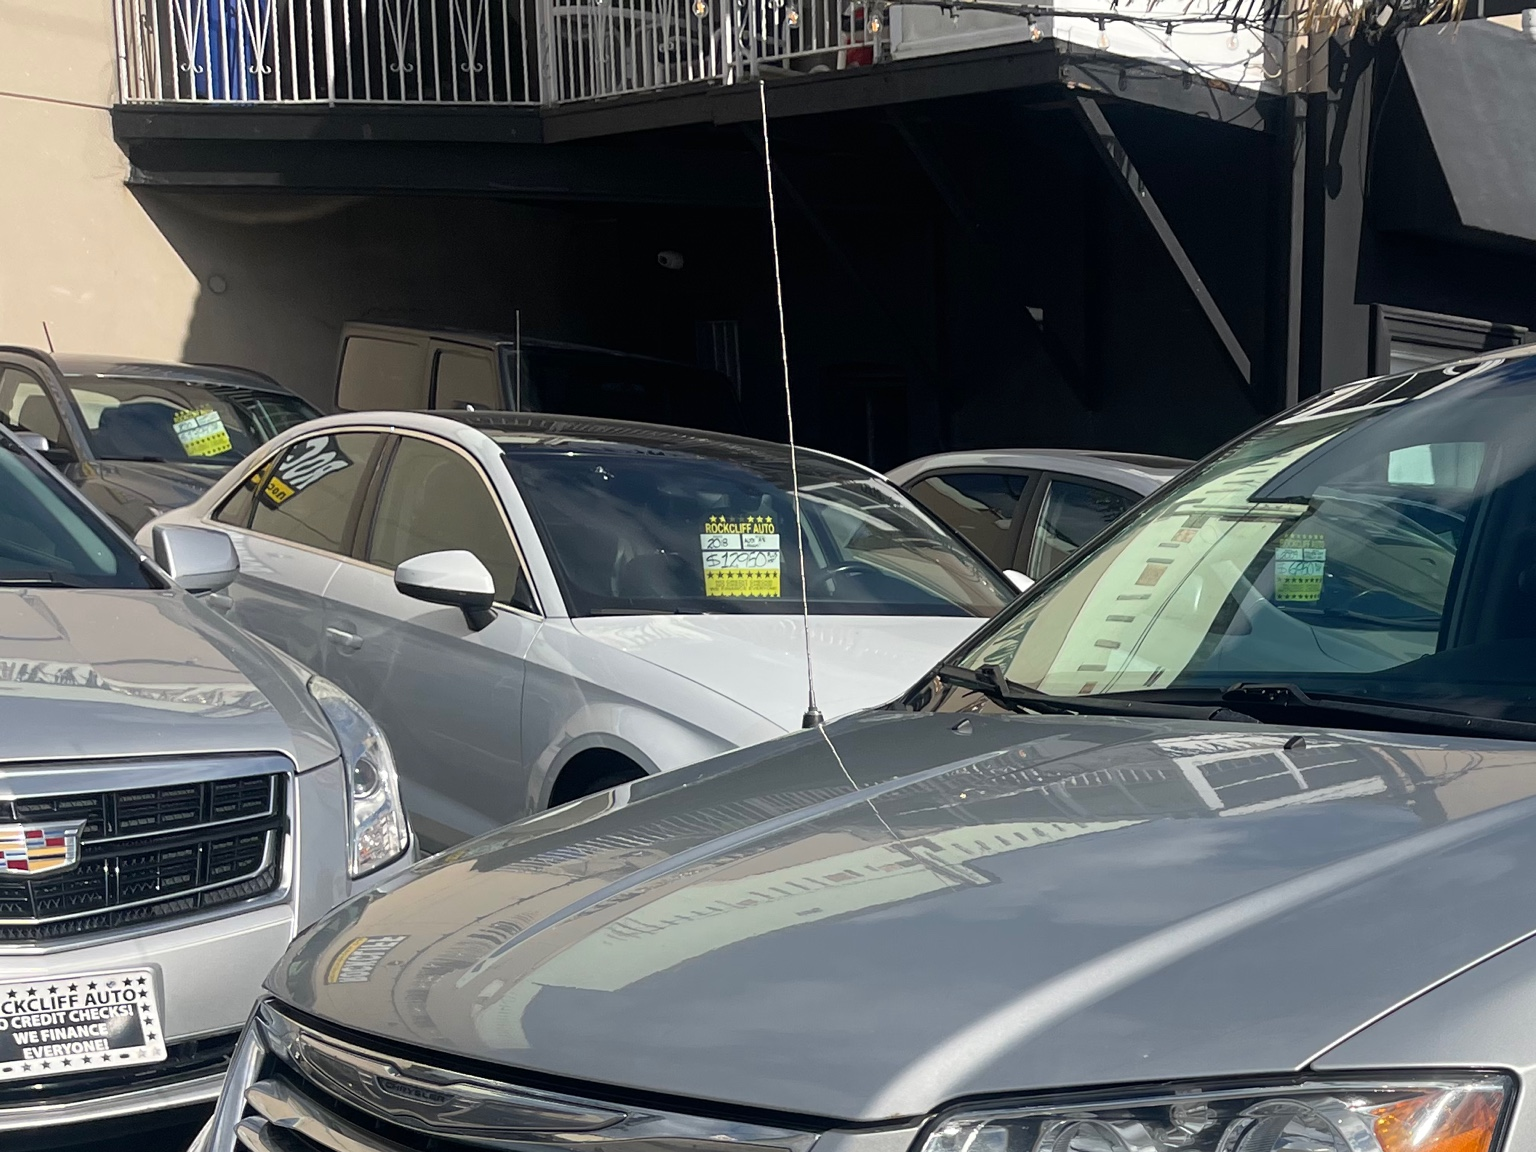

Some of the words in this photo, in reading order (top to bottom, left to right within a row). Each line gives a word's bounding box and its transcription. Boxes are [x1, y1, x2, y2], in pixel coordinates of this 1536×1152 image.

[705, 523, 751, 533] ROCKCLIFF
[753, 523, 774, 533] AUTO
[85, 989, 136, 1006] AUTO
[11, 1012, 66, 1029] CREDIT
[69, 1004, 133, 1022] CHECKS!
[12, 1029, 39, 1045] WE
[40, 1023, 108, 1042] FINANCE
[23, 1039, 109, 1060] EVERYONE!
[385, 1081, 445, 1103] CHRYSLER
